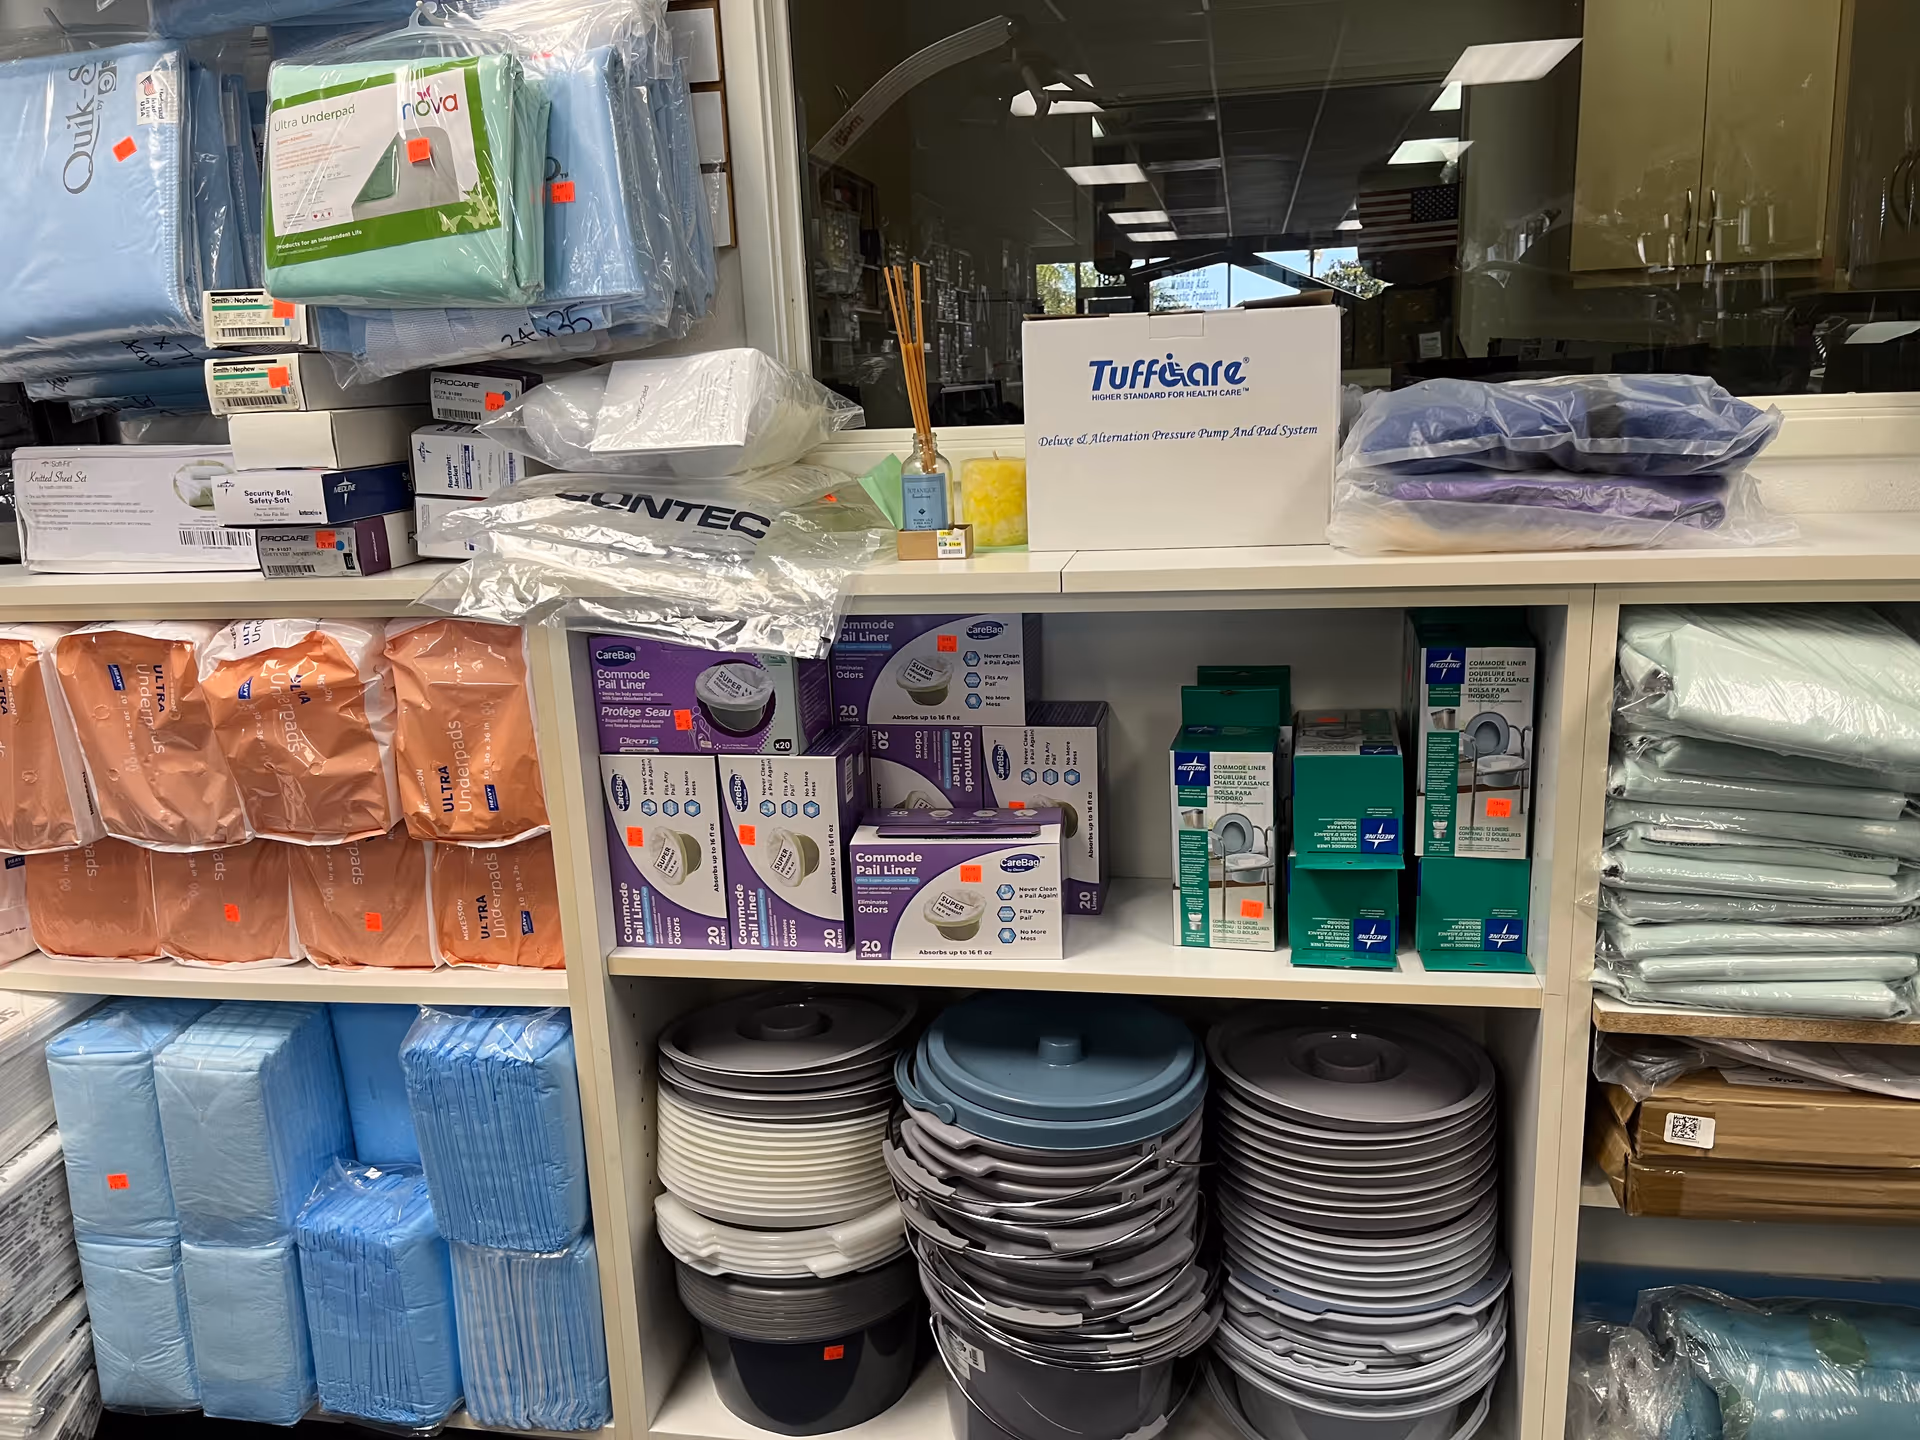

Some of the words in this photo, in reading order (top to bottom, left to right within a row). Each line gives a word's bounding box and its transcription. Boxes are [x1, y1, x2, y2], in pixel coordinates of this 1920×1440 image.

[402, 93, 459, 120] nova
[274, 118, 298, 132] Ultra
[301, 104, 356, 125] Underpad
[301, 238, 310, 247] for
[310, 236, 318, 244] an
[318, 230, 351, 243] Independent
[351, 229, 363, 237] Life
[434, 377, 480, 388] PROCARE
[1091, 393, 1122, 401] HIGHER
[1123, 392, 1166, 400] STANDARD
[1167, 391, 1185, 399] FOR
[1186, 389, 1218, 398] HEALTH
[1038, 435, 1075, 448] Deluxe
[1089, 430, 1150, 446] Alternation
[1151, 429, 1196, 441] Pressure
[1198, 427, 1230, 441] Pump
[1229, 425, 1254, 439] And
[1255, 424, 1278, 437] Pad
[1279, 423, 1319, 438] System
[26, 470, 53, 483] Knitted
[53, 470, 73, 483] Sheet
[73, 471, 87, 483] Set
[244, 489, 274, 498] Security
[276, 489, 293, 497] Belt,
[333, 483, 357, 494] MEDLINE
[248, 497, 290, 505] Safety-Soft
[841, 620, 895, 629] ommode
[966, 625, 1004, 636] CareBag
[865, 632, 890, 642] Liner
[596, 651, 636, 661] CareBag
[597, 669, 650, 680] Commode
[836, 671, 864, 679] Odors
[911, 661, 934, 678] SUPER
[153, 665, 165, 712] ULTRA
[598, 680, 617, 689] Pail
[620, 680, 646, 690] Liner
[718, 670, 742, 691] SUPER
[601, 706, 642, 718] Protège
[645, 707, 671, 717] Seau
[839, 705, 858, 716] 20
[484, 732, 491, 743] 36
[775, 741, 790, 750] x20
[878, 731, 889, 749] 20
[914, 731, 922, 759] Odors
[952, 731, 961, 756] Pail
[445, 720, 473, 812] Underpads
[964, 731, 973, 793] Commode
[997, 745, 1006, 779] CareBag
[952, 758, 961, 788] Liner
[438, 765, 455, 813] ULTRA
[486, 787, 495, 808] HEAVY
[616, 774, 624, 811] CareBag
[735, 774, 743, 812] CareBag
[657, 847, 671, 869] SUPER
[774, 848, 789, 871] SUPER
[855, 852, 923, 863] Commode
[1000, 858, 1040, 868] CareBag
[856, 865, 881, 876] Pail
[883, 865, 917, 876] Liner
[483, 852, 507, 938] Underpads
[632, 888, 642, 917] Liner
[747, 890, 757, 919] Liner
[940, 895, 965, 912] SUPER
[1079, 891, 1090, 909] 20
[475, 895, 491, 939] ULTRA
[619, 882, 633, 943] Commode
[735, 883, 748, 945] Commode
[857, 905, 889, 914] Odors
[636, 919, 646, 943] Pail
[673, 917, 681, 945] Odors
[707, 926, 720, 945] 20
[750, 921, 760, 945] Pail
[789, 919, 798, 947] Odors
[824, 929, 837, 948] 20
[861, 941, 881, 952] 20
